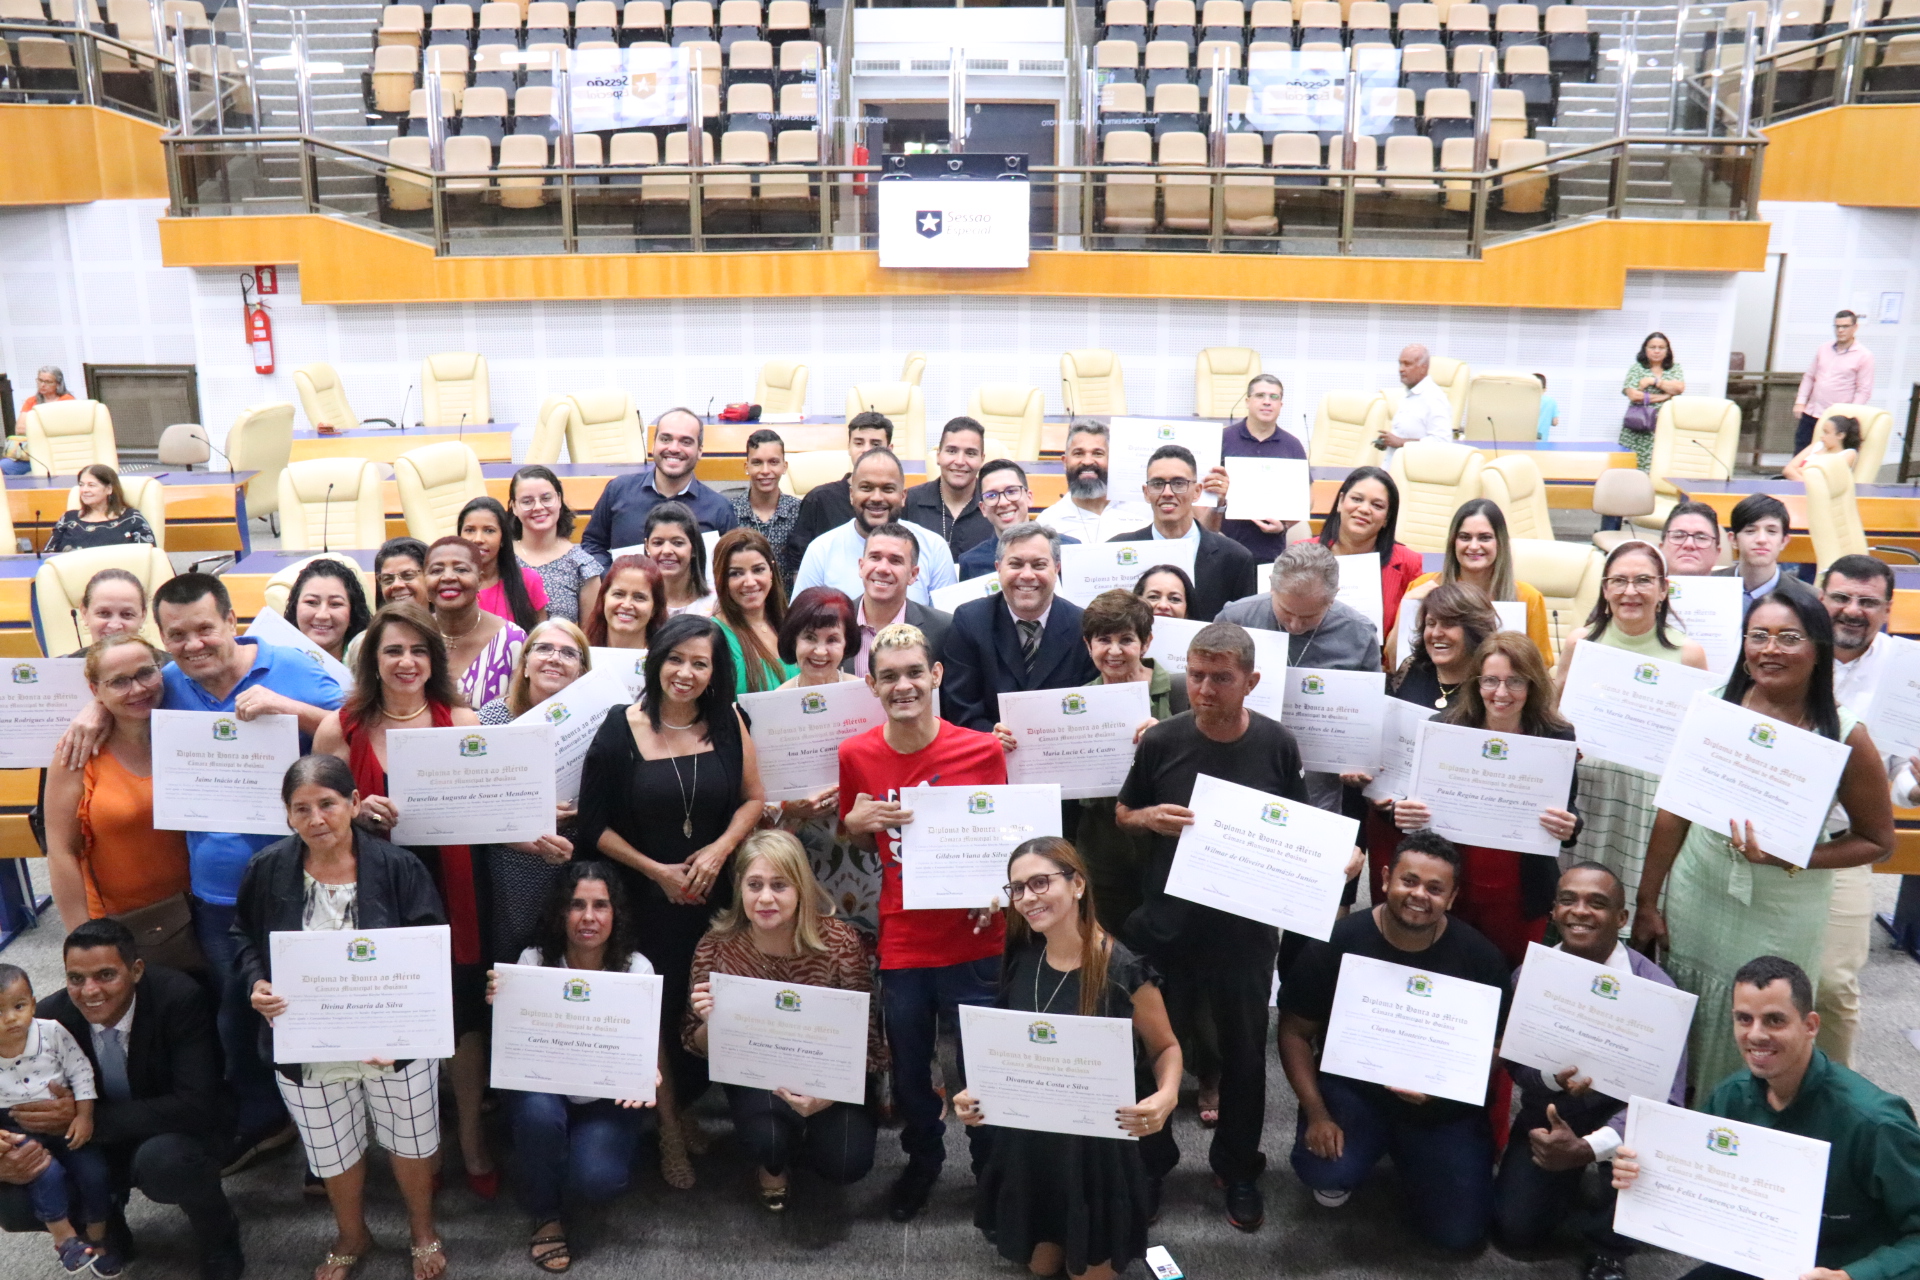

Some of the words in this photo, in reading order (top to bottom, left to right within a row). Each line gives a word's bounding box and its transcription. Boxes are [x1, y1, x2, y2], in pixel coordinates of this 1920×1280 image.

[947, 226, 991, 236] Especial
[566, 749, 588, 766] Aparecid
[1437, 788, 1456, 796] Paula
[1456, 791, 1479, 801] Regina
[1204, 845, 1228, 858] Wilmar
[1229, 852, 1238, 860] de
[1238, 855, 1265, 869] Oliveira
[321, 1002, 344, 1010] Divina
[346, 1002, 373, 1010] Rosaria
[1553, 1021, 1575, 1034] Carlos
[1371, 1024, 1396, 1036] Clayton
[1398, 1029, 1427, 1041] Monteiro
[1428, 1036, 1450, 1046] Santos
[528, 1036, 549, 1044] Carlos
[551, 1038, 575, 1047] Miguel
[575, 1040, 592, 1048] Silva
[593, 1042, 620, 1050] Campos
[774, 1043, 795, 1052] Soares
[1046, 1080, 1065, 1088] Costa
[1071, 1082, 1089, 1090] Silva
[1736, 1204, 1758, 1217] Silva
[1759, 1210, 1779, 1224] Cruz
